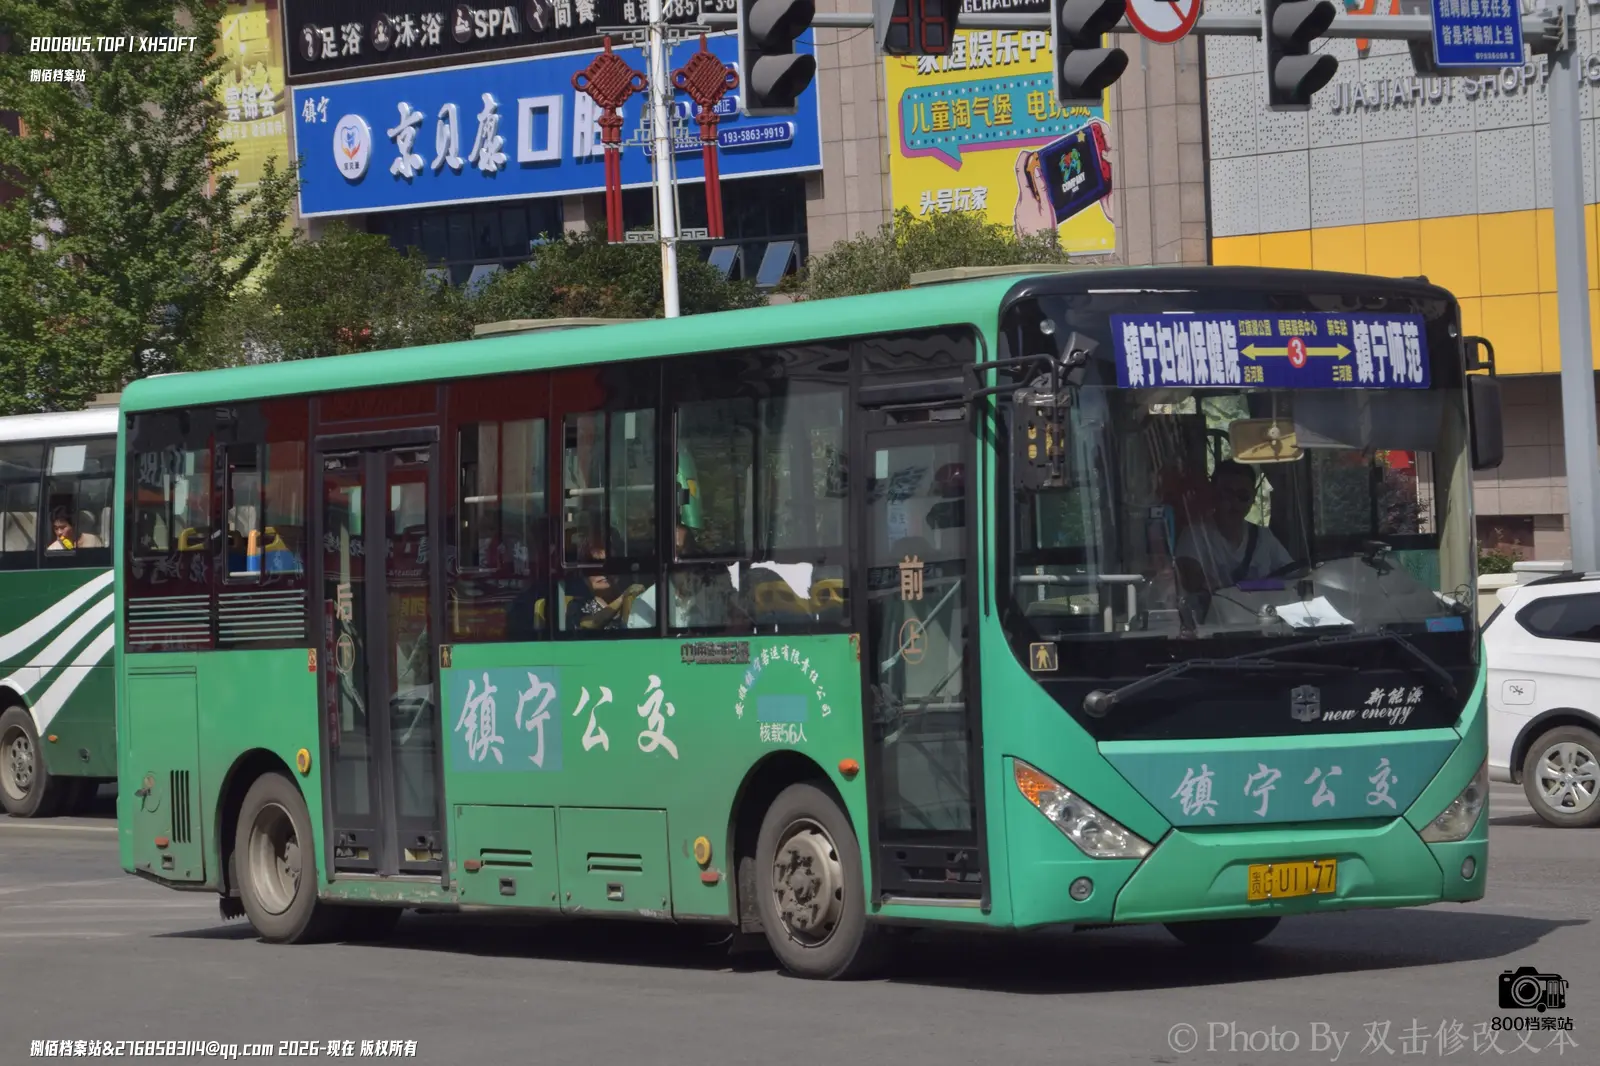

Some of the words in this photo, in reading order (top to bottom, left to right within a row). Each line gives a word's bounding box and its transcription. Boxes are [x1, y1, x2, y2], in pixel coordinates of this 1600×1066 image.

[321, 22, 363, 58] 足浴
[394, 13, 443, 48] 沐浴
[474, 6, 518, 39] SPA
[1442, 25, 1514, 46] 皆是诈骗别上当
[918, 30, 1052, 75] 家庭娱乐中
[302, 95, 330, 123] 镇宁
[911, 93, 1013, 134] 儿童淘气堡
[723, 127, 785, 143] 193-5863-9919
[919, 187, 988, 215] 头号玩家
[1291, 339, 1304, 365] 3
[1352, 320, 1423, 383] 镇宁师范
[899, 555, 924, 600] 前
[336, 583, 353, 620] 后
[903, 624, 922, 653] 上
[1364, 686, 1424, 707] 新能源
[454, 671, 679, 768] 镇宁公交
[1322, 709, 1359, 721] new
[1361, 706, 1415, 725] energy
[759, 723, 808, 745] 核载56人
[1170, 757, 1398, 817] 镇宁公交
